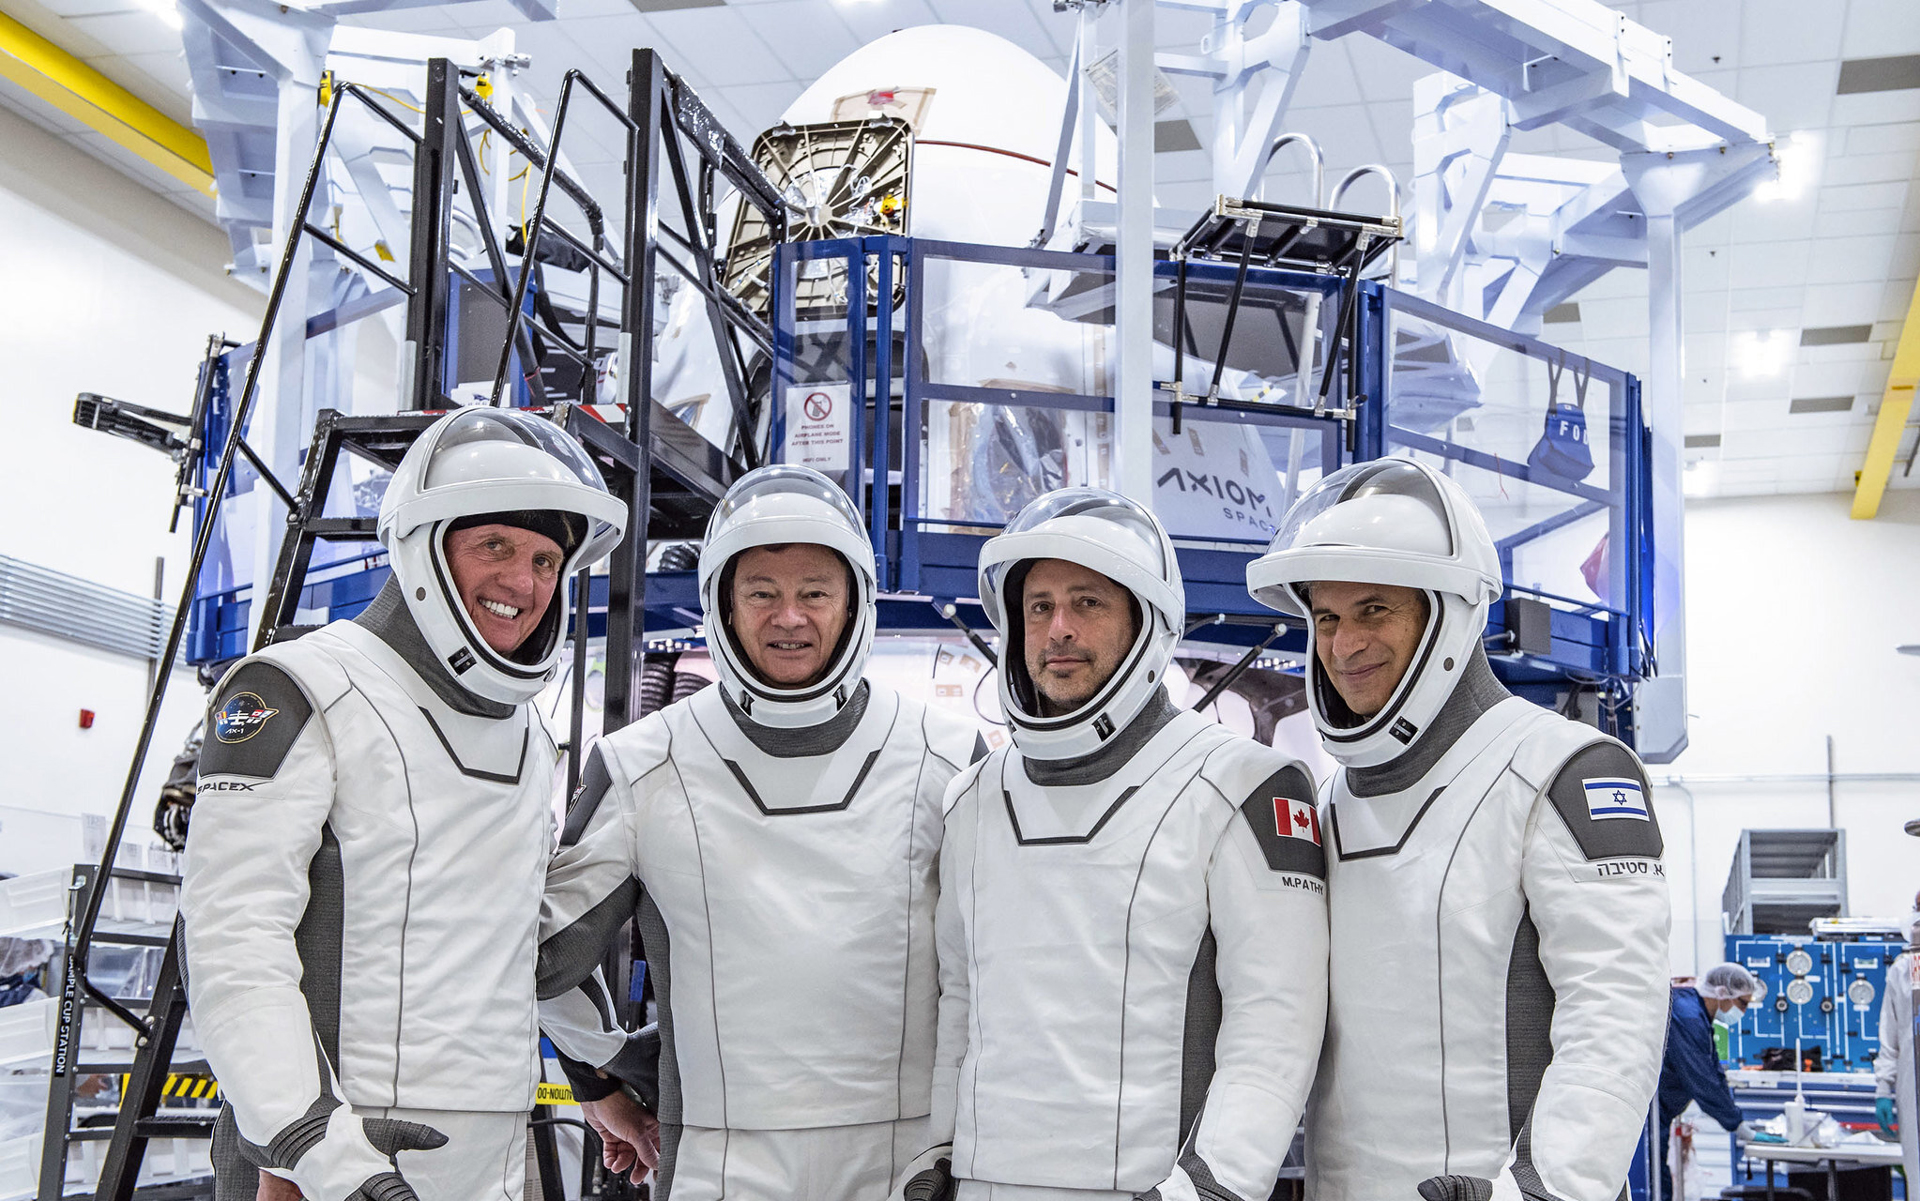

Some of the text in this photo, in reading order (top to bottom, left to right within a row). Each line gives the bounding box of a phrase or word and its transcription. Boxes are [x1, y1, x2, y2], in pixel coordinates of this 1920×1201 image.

[1157, 467, 1272, 518] AXIOM
[197, 781, 274, 795] SPACEX
[1596, 861, 1648, 876] סטיבה
[1282, 876, 1323, 894] M.PATHY
[62, 1000, 73, 1023] CUP
[56, 1025, 70, 1073] STATION
